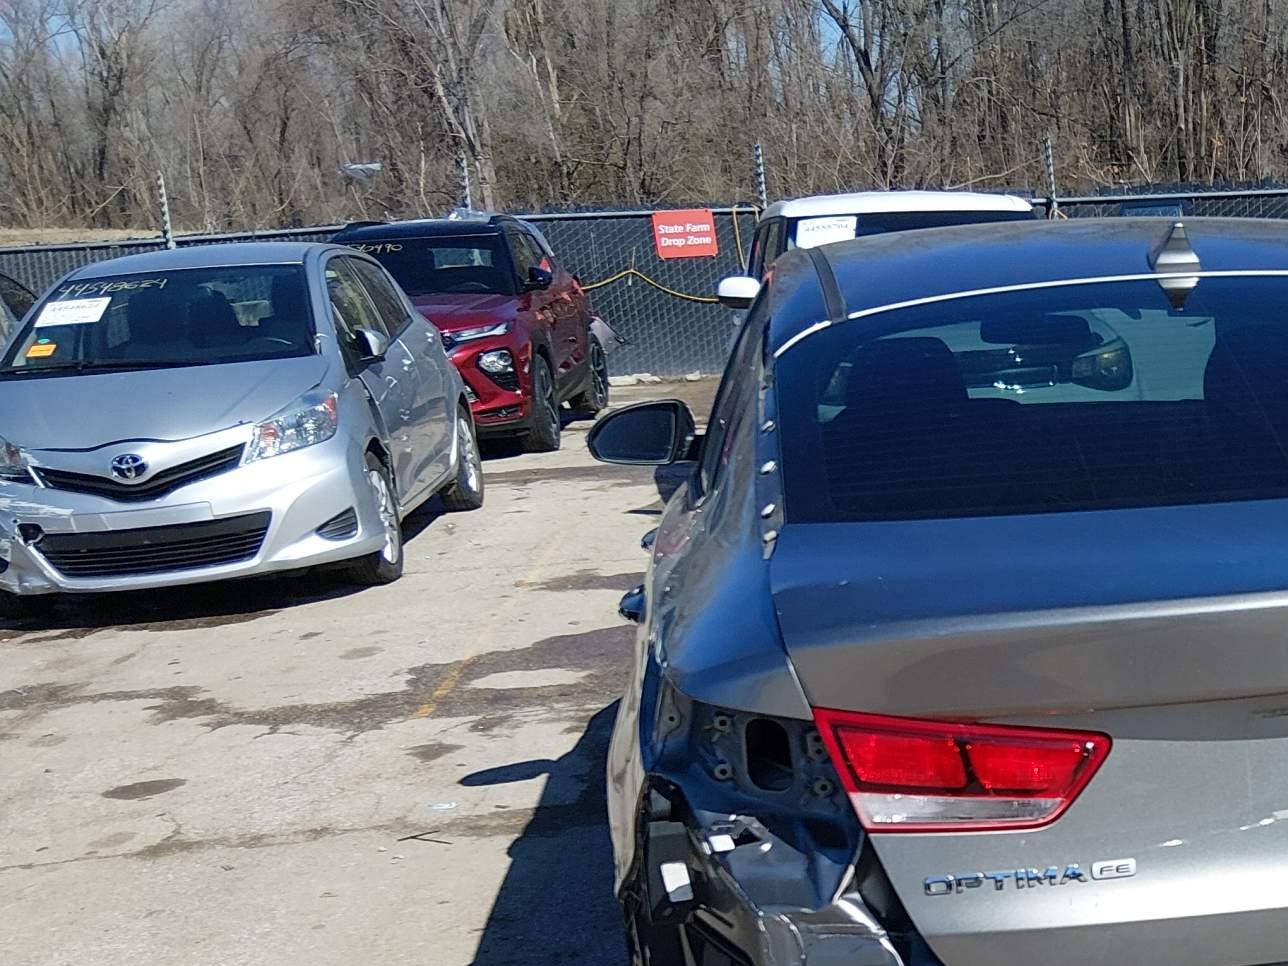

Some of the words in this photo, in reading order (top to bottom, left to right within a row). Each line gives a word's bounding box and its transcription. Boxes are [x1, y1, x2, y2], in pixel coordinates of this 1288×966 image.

[658, 224, 684, 234] State
[686, 223, 710, 233] Farm
[661, 236, 685, 247] Drop
[687, 235, 712, 245] Zone
[924, 863, 1088, 897] OPTIMA
[1099, 863, 1131, 876] FE
